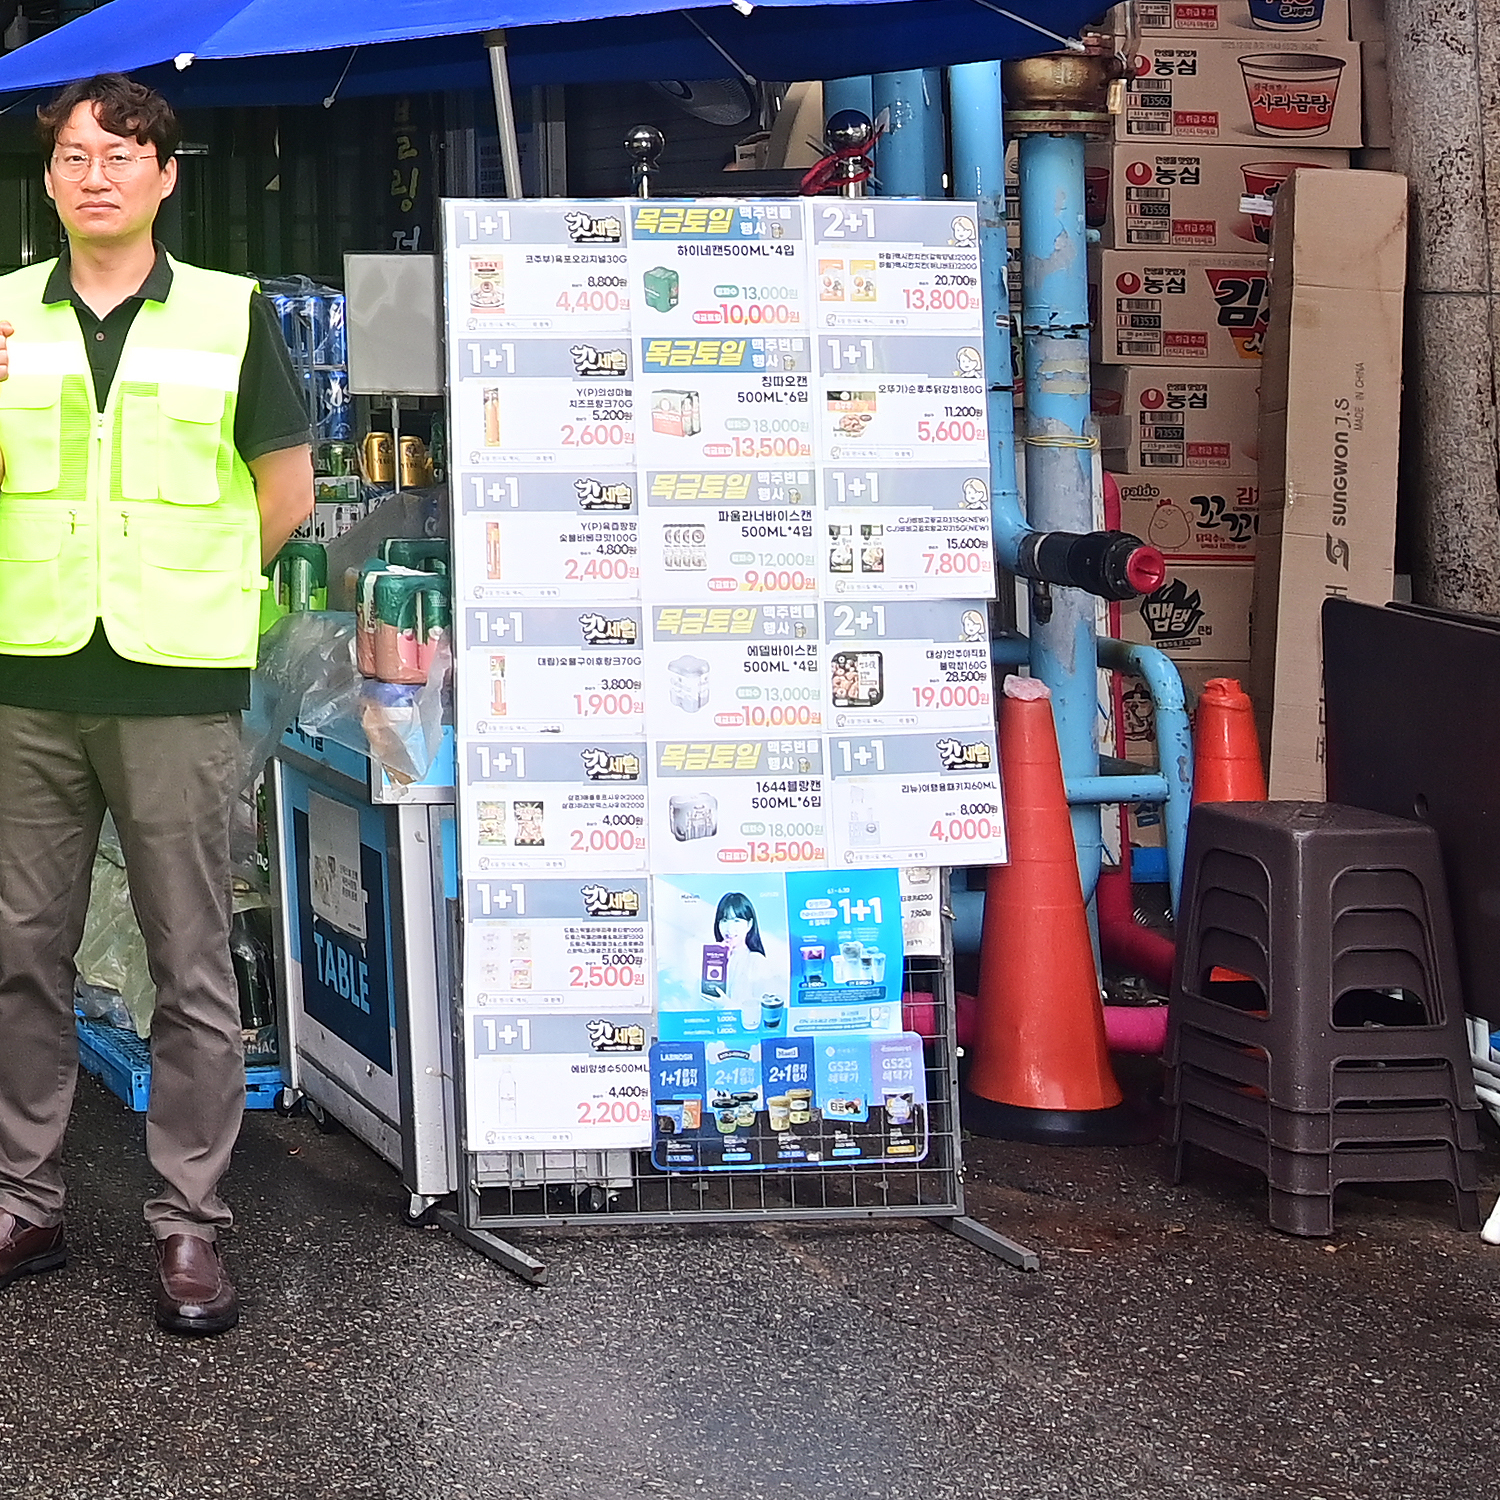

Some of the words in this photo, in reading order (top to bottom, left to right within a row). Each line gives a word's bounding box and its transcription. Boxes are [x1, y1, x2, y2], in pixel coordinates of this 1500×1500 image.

[1154, 57, 1197, 77] 농심
[1253, 92, 1332, 113] 사리곰탕
[1155, 165, 1200, 185] 농심
[464, 210, 511, 240] 1+1
[635, 208, 734, 234] 목금토일
[822, 207, 876, 238] 2+1
[742, 287, 798, 300] 13,000원
[1143, 277, 1186, 294] 농심
[556, 291, 629, 312] 4,400원
[903, 289, 980, 311] 13,800원
[1214, 278, 1269, 327] 김
[720, 304, 800, 326] 10,000원
[468, 343, 515, 374] 1+1
[646, 340, 746, 366] 목금토일
[827, 339, 875, 370] 1+1
[761, 376, 808, 388] 칭따오캔
[1166, 392, 1208, 409] 농심
[561, 425, 634, 446] 2,600원
[754, 419, 809, 432] 18,000원
[917, 420, 986, 443] 5,600원
[732, 436, 811, 458] 13,500원
[471, 477, 519, 507] 1+1
[651, 474, 751, 500] 목금토일
[832, 472, 880, 503] 1+1
[1121, 485, 1160, 500] paldo
[565, 559, 639, 580] 2,400원
[758, 553, 815, 567] 12,000원
[922, 552, 992, 575] 7,800원
[744, 570, 816, 593] 9,000원
[475, 612, 523, 642] 1+1
[657, 608, 757, 634] 목금토일
[833, 605, 886, 637] 2+1
[1148, 602, 1191, 632] 맵탱
[743, 661, 790, 673] 500ML
[574, 694, 644, 715] 1,900원
[764, 687, 820, 700] 13,000원
[912, 686, 990, 708] 19,000원
[741, 706, 822, 727] 10,000원
[477, 747, 525, 777] 1+1
[660, 743, 762, 770] 목금토일
[838, 740, 886, 772] 1+1
[756, 780, 822, 792] 1644블랑캔
[571, 830, 645, 851] 2,000원
[768, 823, 824, 837] 18,000원
[929, 818, 1002, 842] 4,000원
[747, 841, 825, 863] 13,500원
[477, 884, 525, 914] 1+1
[838, 897, 883, 924] 1+1
[313, 931, 371, 1015] TABLE
[570, 966, 645, 987] 2,500원
[483, 1019, 531, 1050] 1+1
[769, 1064, 792, 1082] 2+1
[828, 1060, 859, 1072] GS25
[882, 1058, 913, 1069] GS25
[577, 1102, 651, 1124] 2,200원
